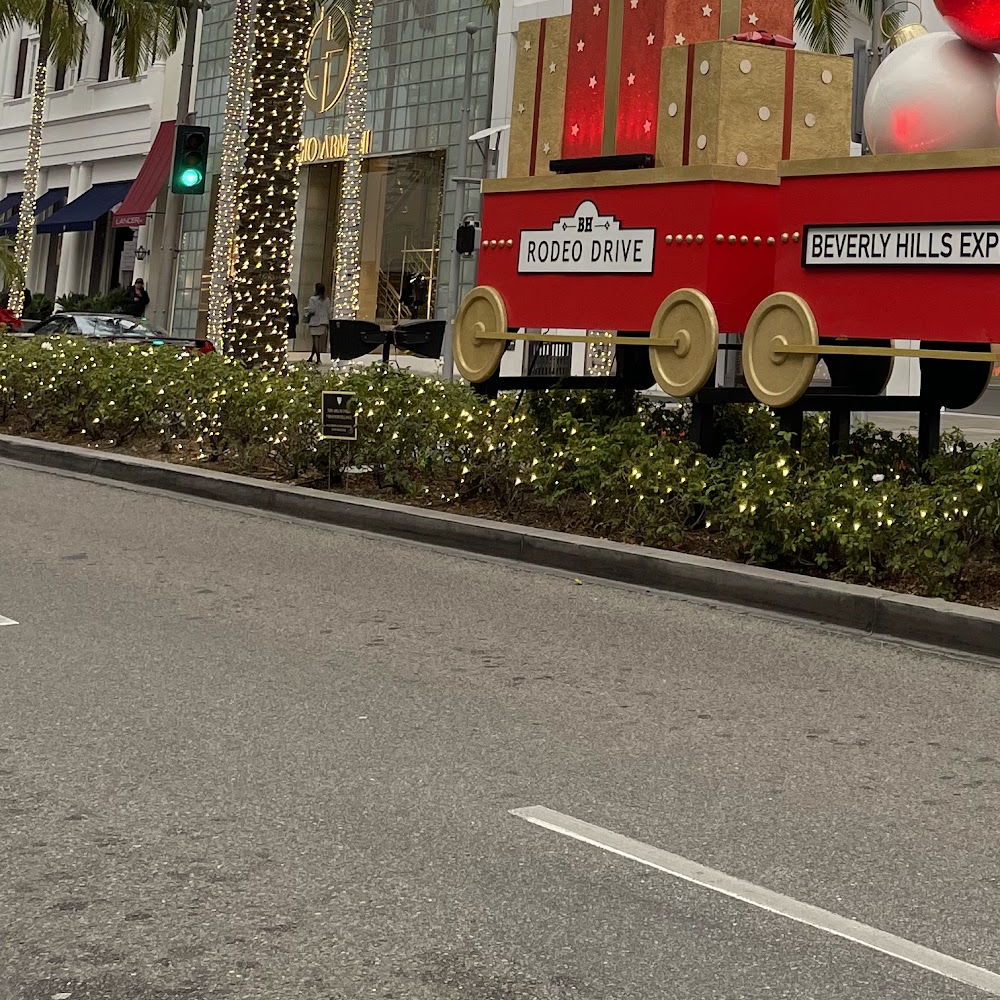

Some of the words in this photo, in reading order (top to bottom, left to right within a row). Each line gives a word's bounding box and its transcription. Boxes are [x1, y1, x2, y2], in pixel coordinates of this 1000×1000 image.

[577, 216, 593, 232] BH
[527, 240, 583, 263] RODEO
[591, 239, 644, 262] DRIVE
[811, 233, 891, 258] BEVERLY
[896, 232, 953, 258] HILLS
